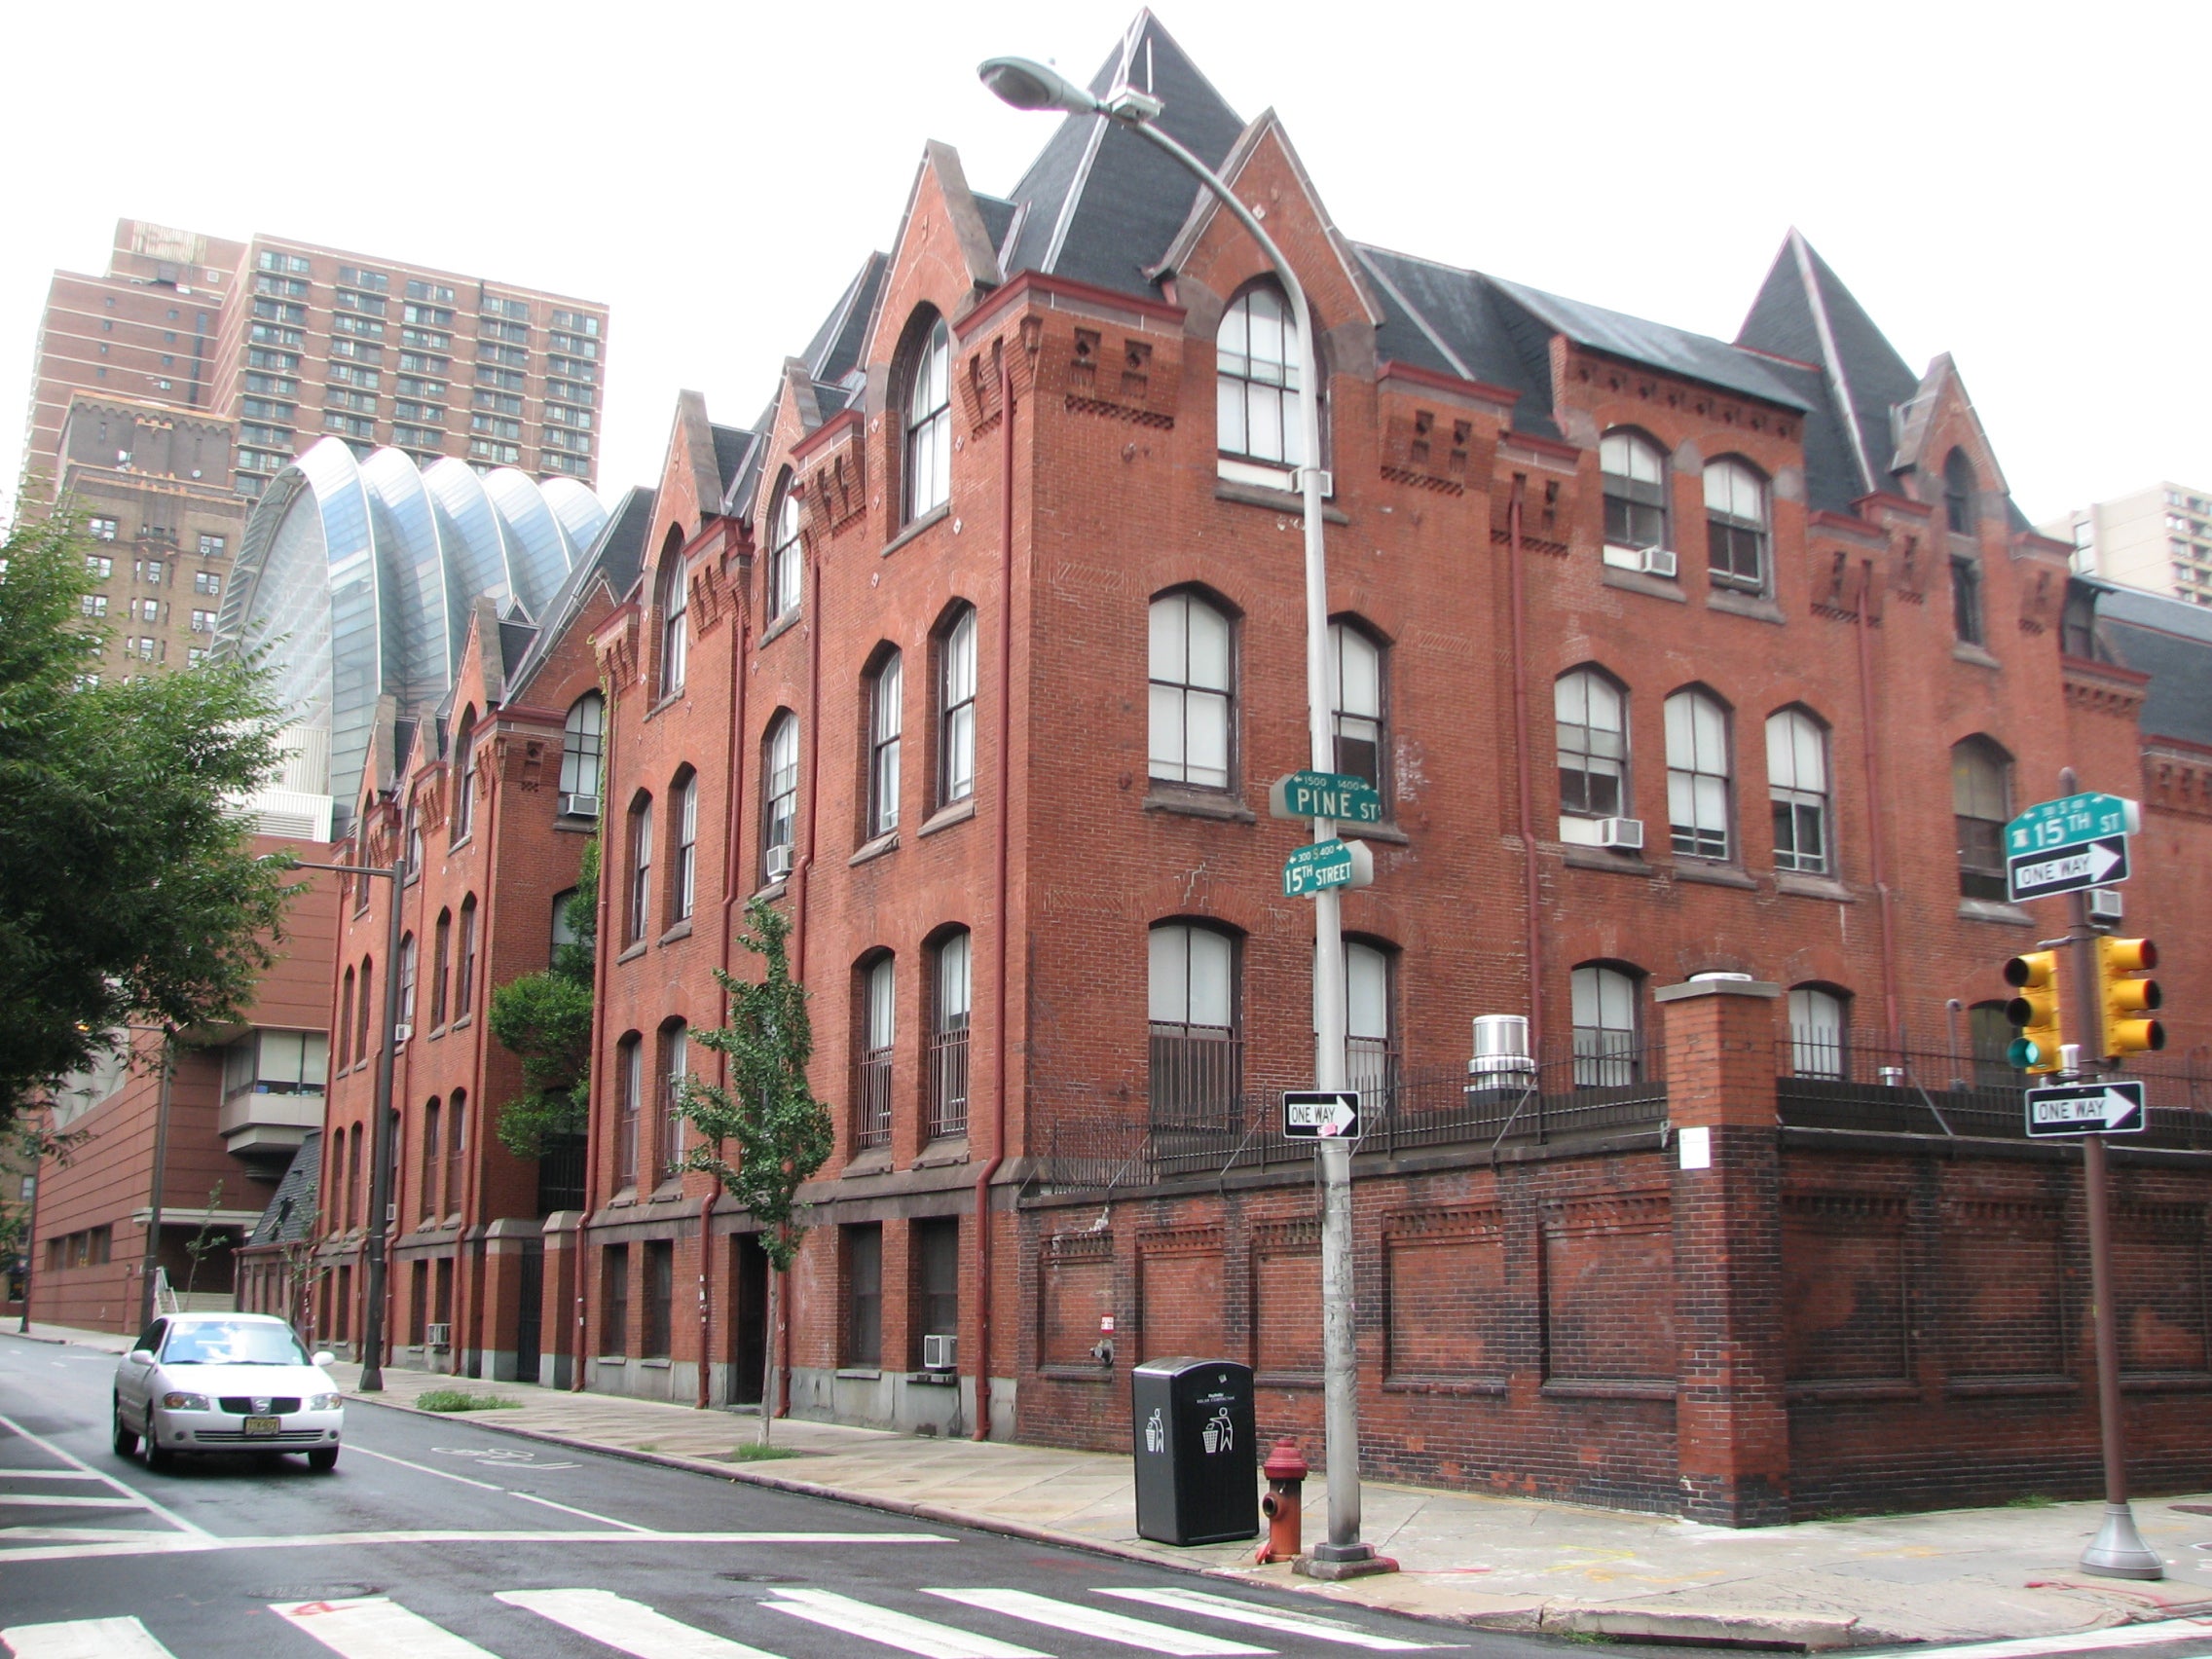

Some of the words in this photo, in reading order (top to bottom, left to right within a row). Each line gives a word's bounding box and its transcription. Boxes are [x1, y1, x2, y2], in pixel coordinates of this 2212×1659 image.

[1305, 777, 1327, 787] 1500
[1338, 780, 1359, 791] 1400
[1298, 788, 1351, 817] PINE
[1360, 803, 1377, 821] ST
[2034, 812, 2091, 847] 15TH
[2100, 813, 2120, 832] ST
[1312, 848, 1319, 861] S
[1286, 865, 1313, 894] 15TH
[1315, 862, 1351, 886] STREET
[2021, 864, 2055, 885] ONE
[2061, 855, 2090, 876] WAY
[1291, 1106, 1311, 1124] ONE
[1314, 1106, 1336, 1124] WAY
[2039, 1102, 2070, 1121] ONE
[2074, 1099, 2105, 1118] WAY
